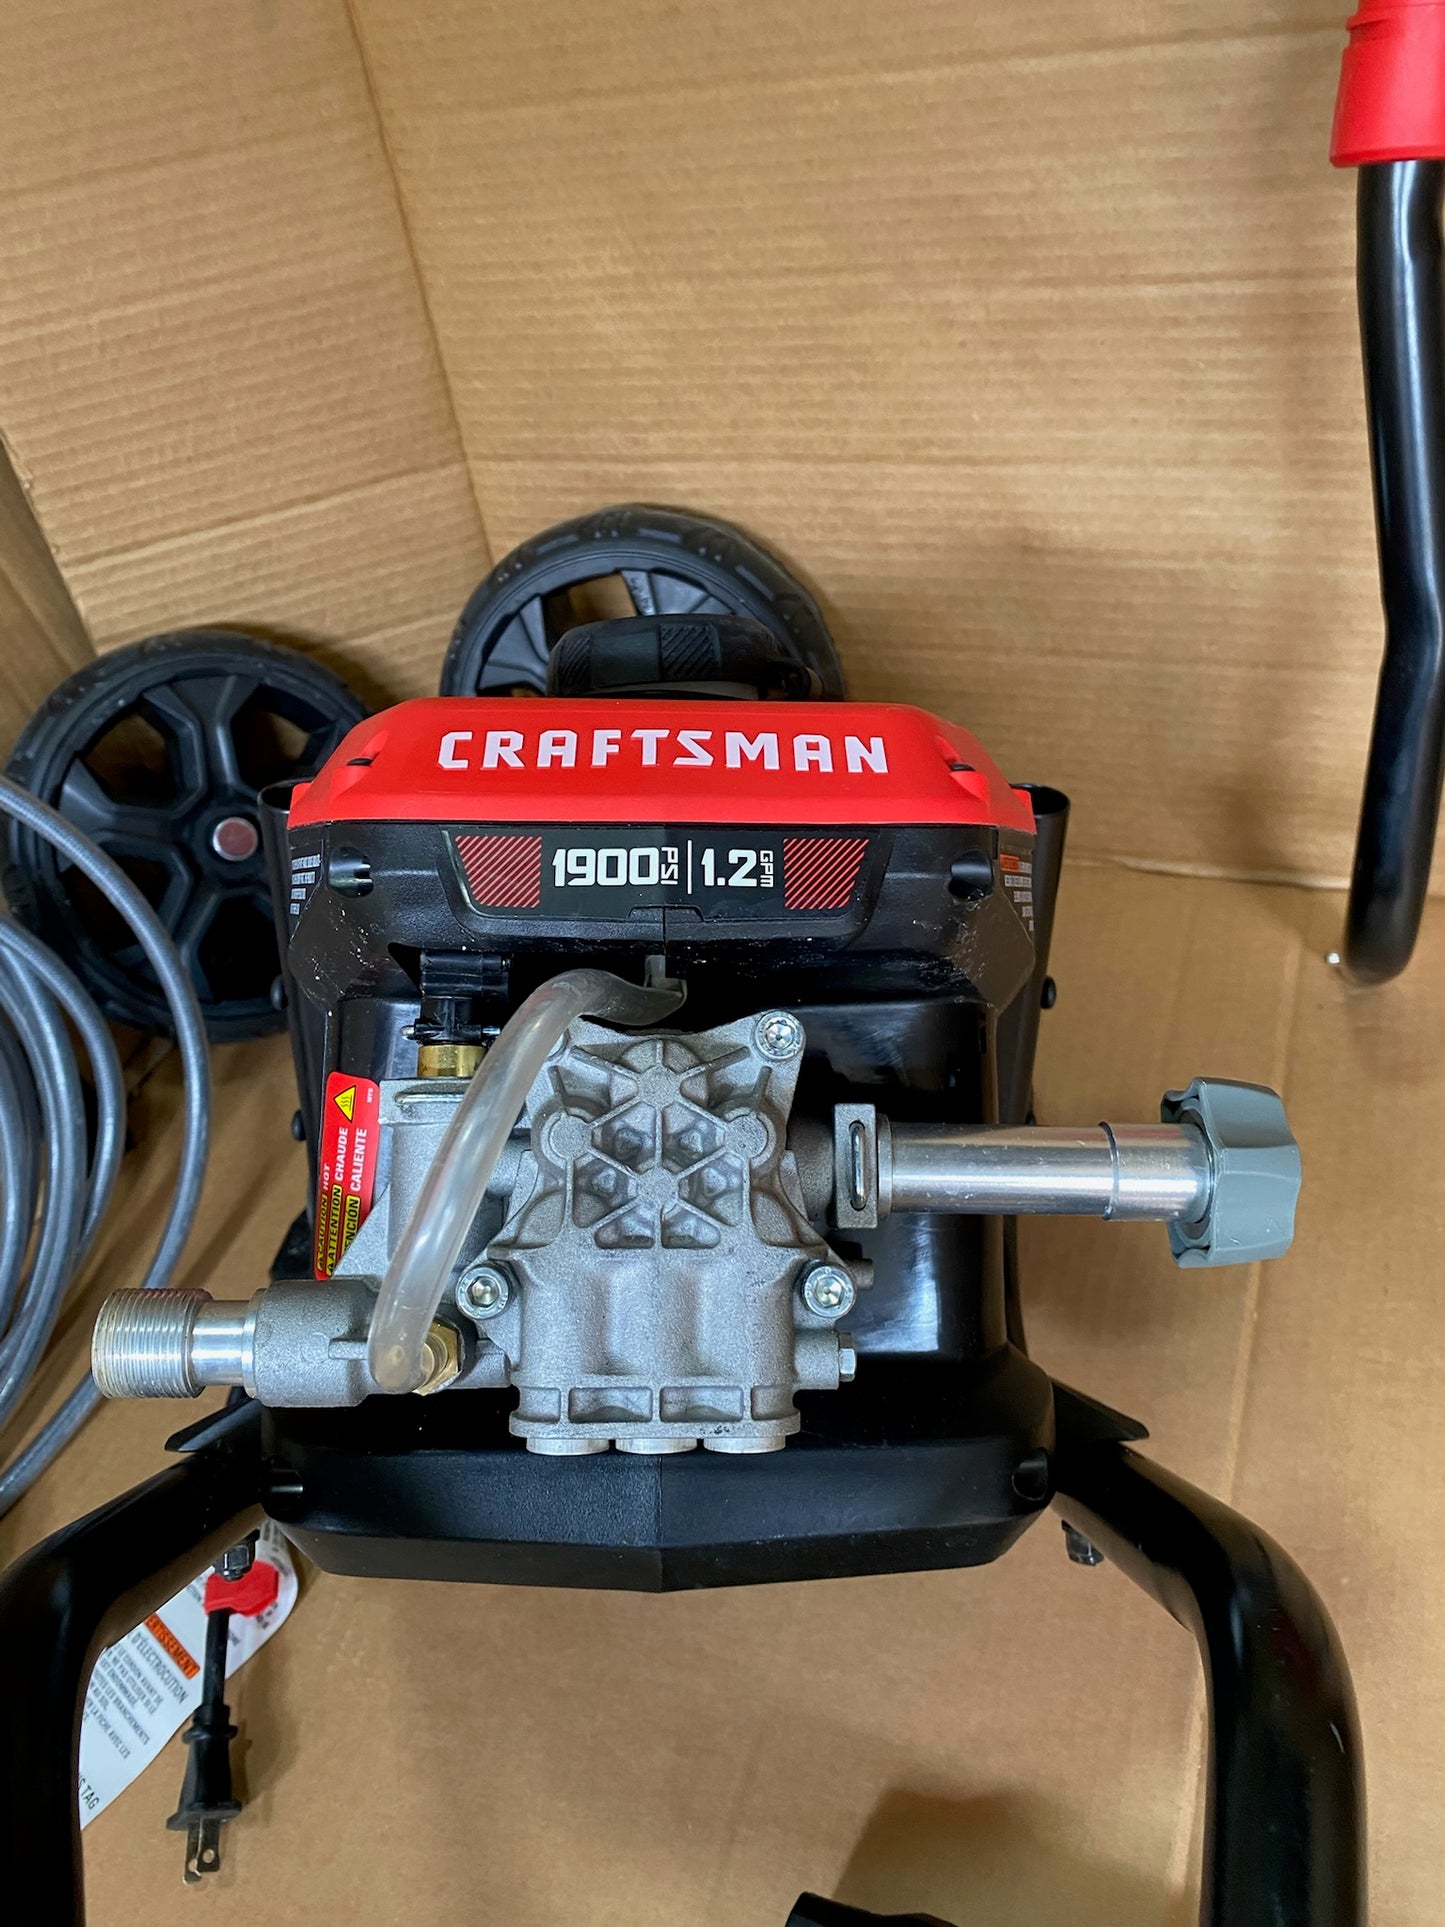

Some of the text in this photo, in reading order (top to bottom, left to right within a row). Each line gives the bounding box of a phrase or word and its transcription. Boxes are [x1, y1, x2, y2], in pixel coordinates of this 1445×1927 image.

[437, 728, 889, 773] CRAFTSMAN
[552, 846, 774, 888] 1900 PSI 1.2 GPM
[350, 1127, 368, 1192] CALIENTE
[318, 1162, 331, 1256] CAUTION HOT
[327, 1126, 349, 1259] ATTENTION CHAUDE
[144, 1614, 198, 1677] ERTISSEMENT
[81, 1784, 100, 1810] TAG
